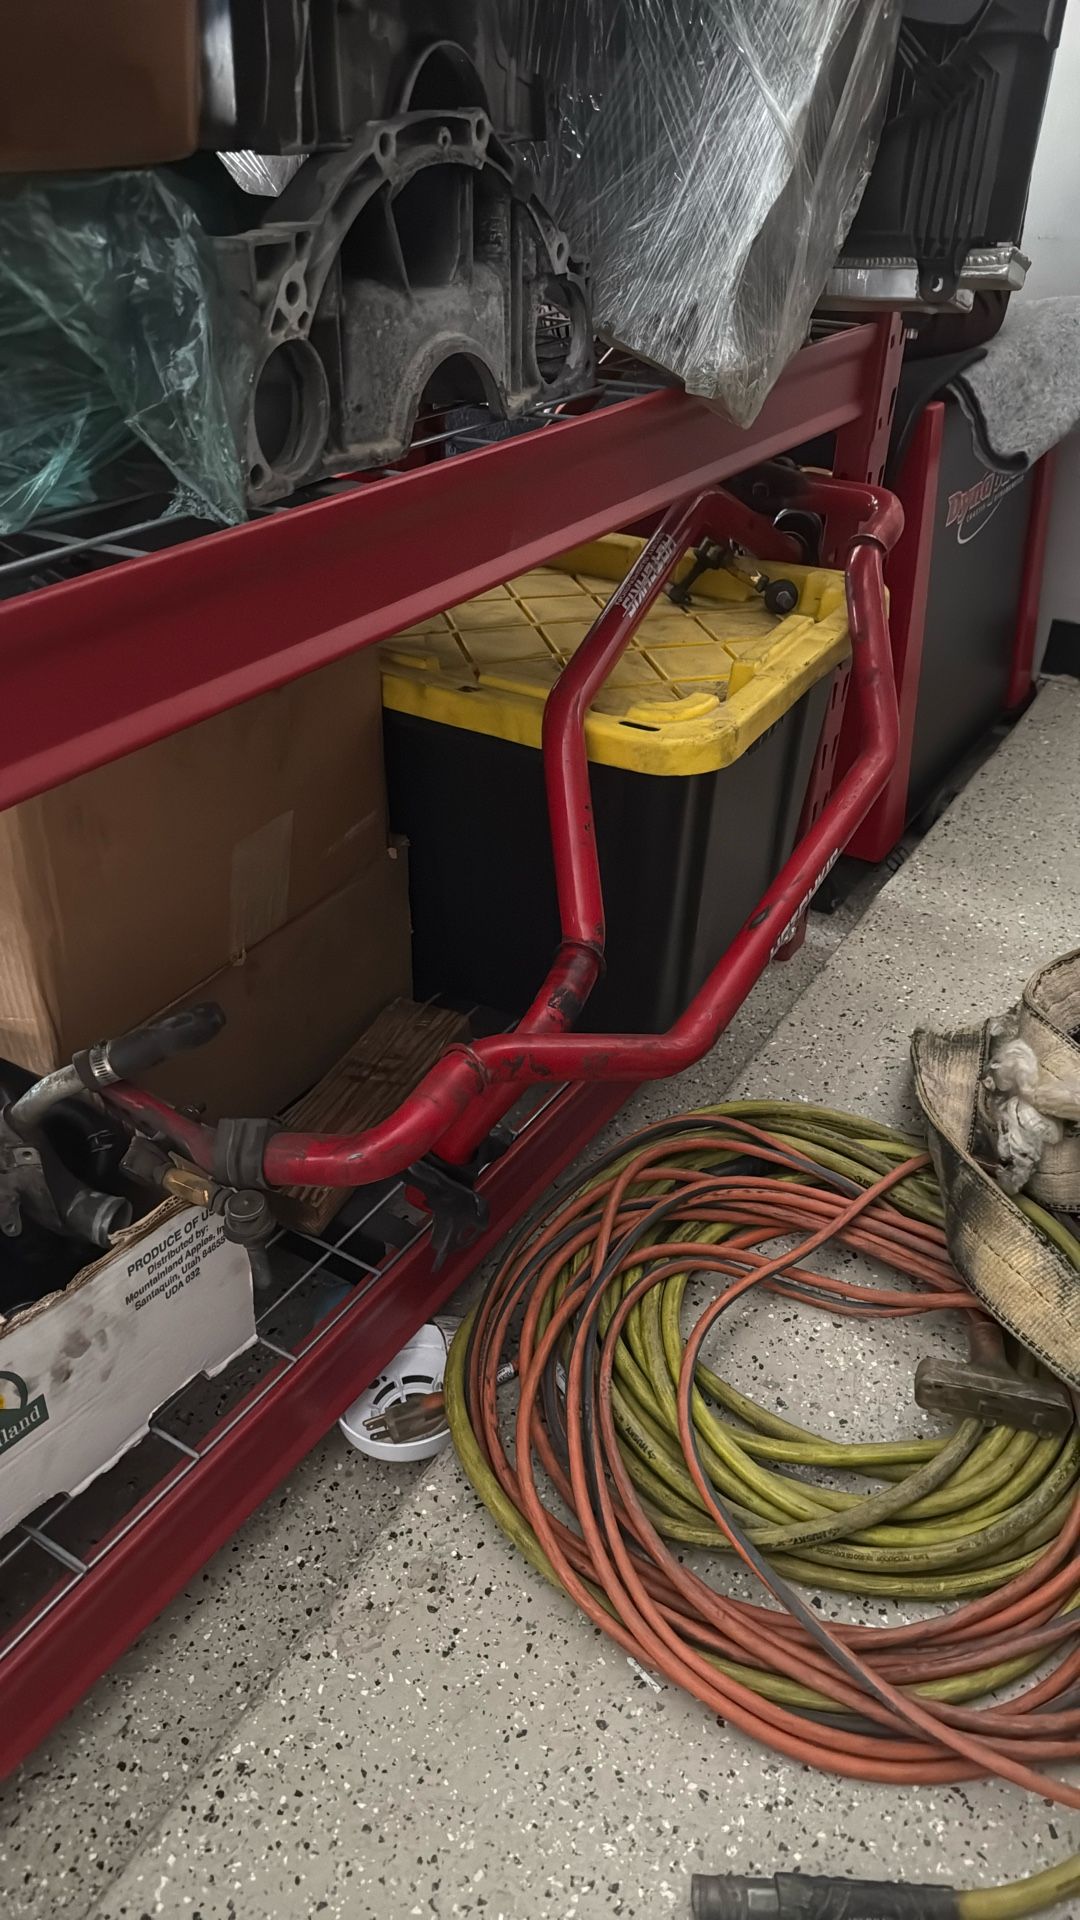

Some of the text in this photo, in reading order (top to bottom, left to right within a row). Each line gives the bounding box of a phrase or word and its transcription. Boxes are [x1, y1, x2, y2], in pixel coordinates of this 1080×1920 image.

[622, 533, 677, 618] HOTCHKIS
[125, 1259, 184, 1305] Mountainland
[185, 1231, 216, 1260] Apples,
[127, 1230, 182, 1277] PRODUCE
[184, 1215, 200, 1234] OF
[147, 1224, 209, 1276] Distributed by:
[134, 1274, 181, 1311] Santaquin,
[181, 1255, 201, 1275] Utah
[165, 1266, 201, 1300] UDA 032
[0, 1404, 41, 1448] land
